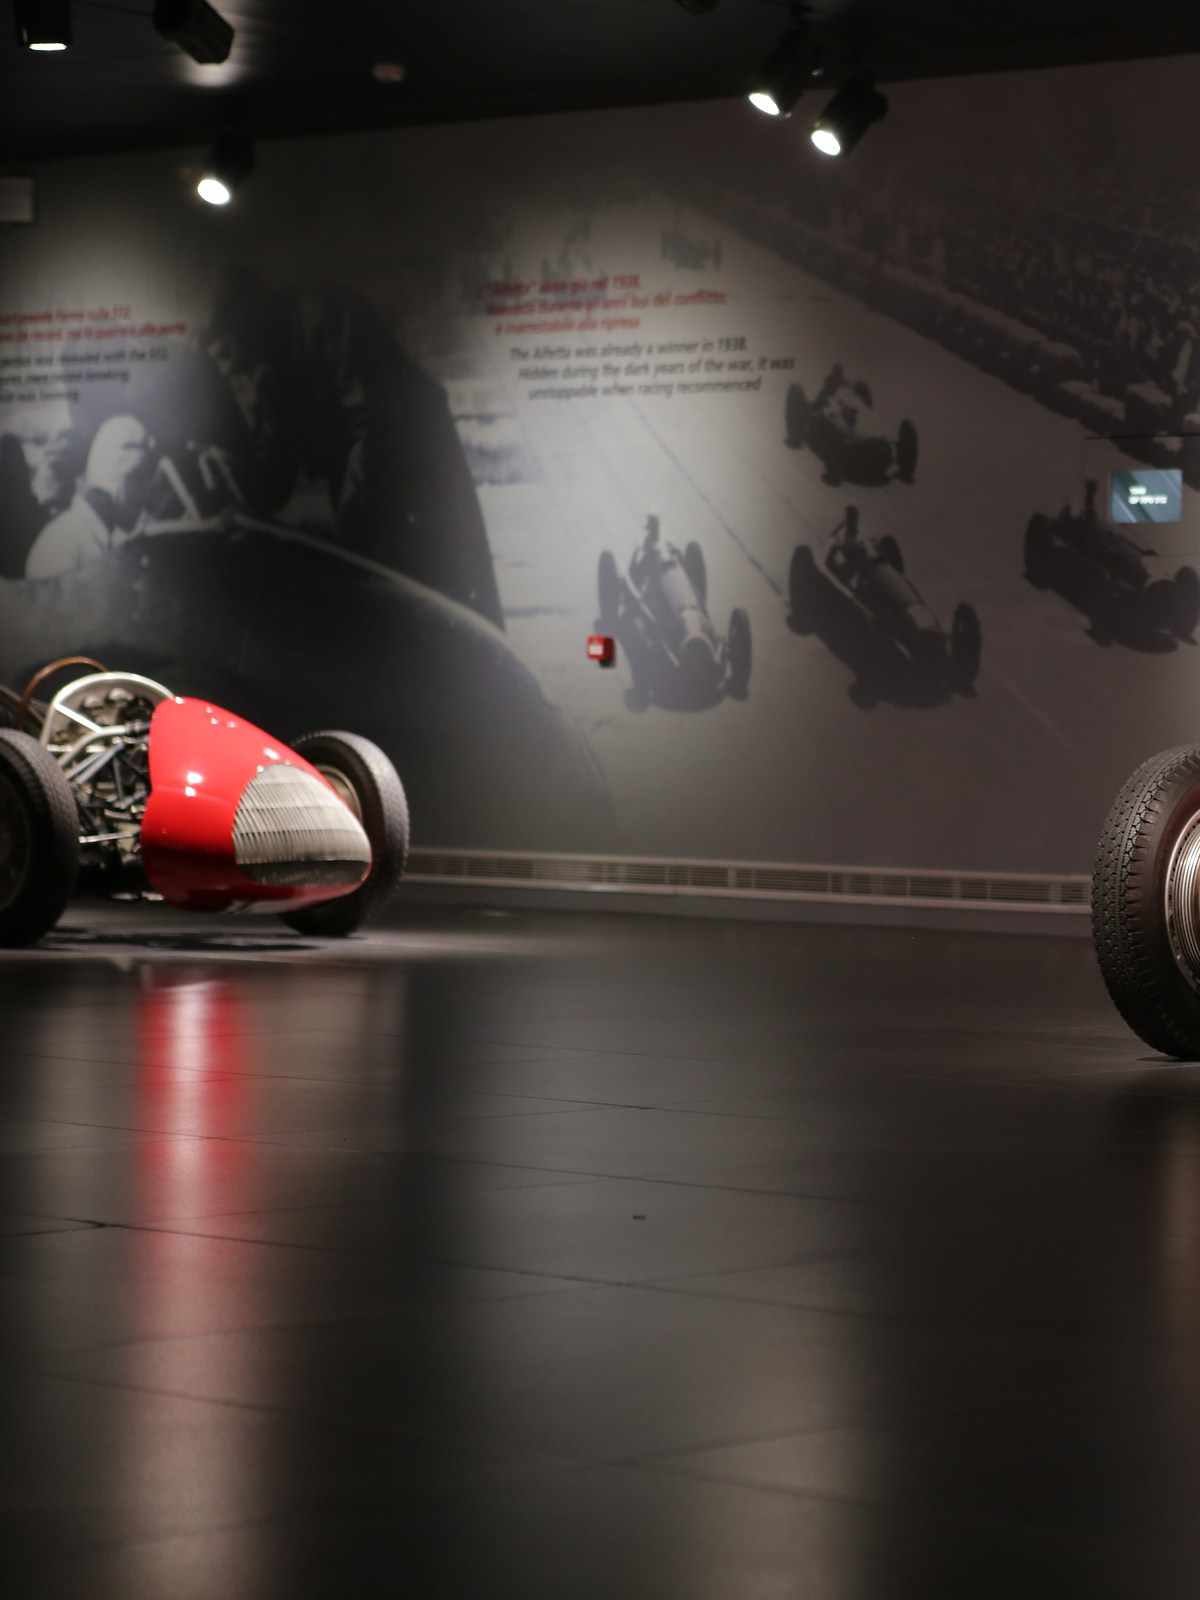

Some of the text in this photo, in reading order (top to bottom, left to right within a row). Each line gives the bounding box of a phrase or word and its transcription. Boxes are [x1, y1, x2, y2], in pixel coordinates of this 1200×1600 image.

[510, 345, 529, 360] The
[532, 344, 571, 359] Alfetta
[575, 345, 597, 358] was
[600, 341, 642, 359] already
[657, 342, 699, 354] winner
[562, 364, 599, 382] during
[602, 363, 621, 376] the
[624, 361, 650, 376] dark
[652, 362, 684, 378] years
[704, 359, 724, 373] the
[770, 358, 796, 370] was
[602, 381, 635, 396] when
[637, 381, 674, 399] racing
[676, 377, 762, 394] recommenced
